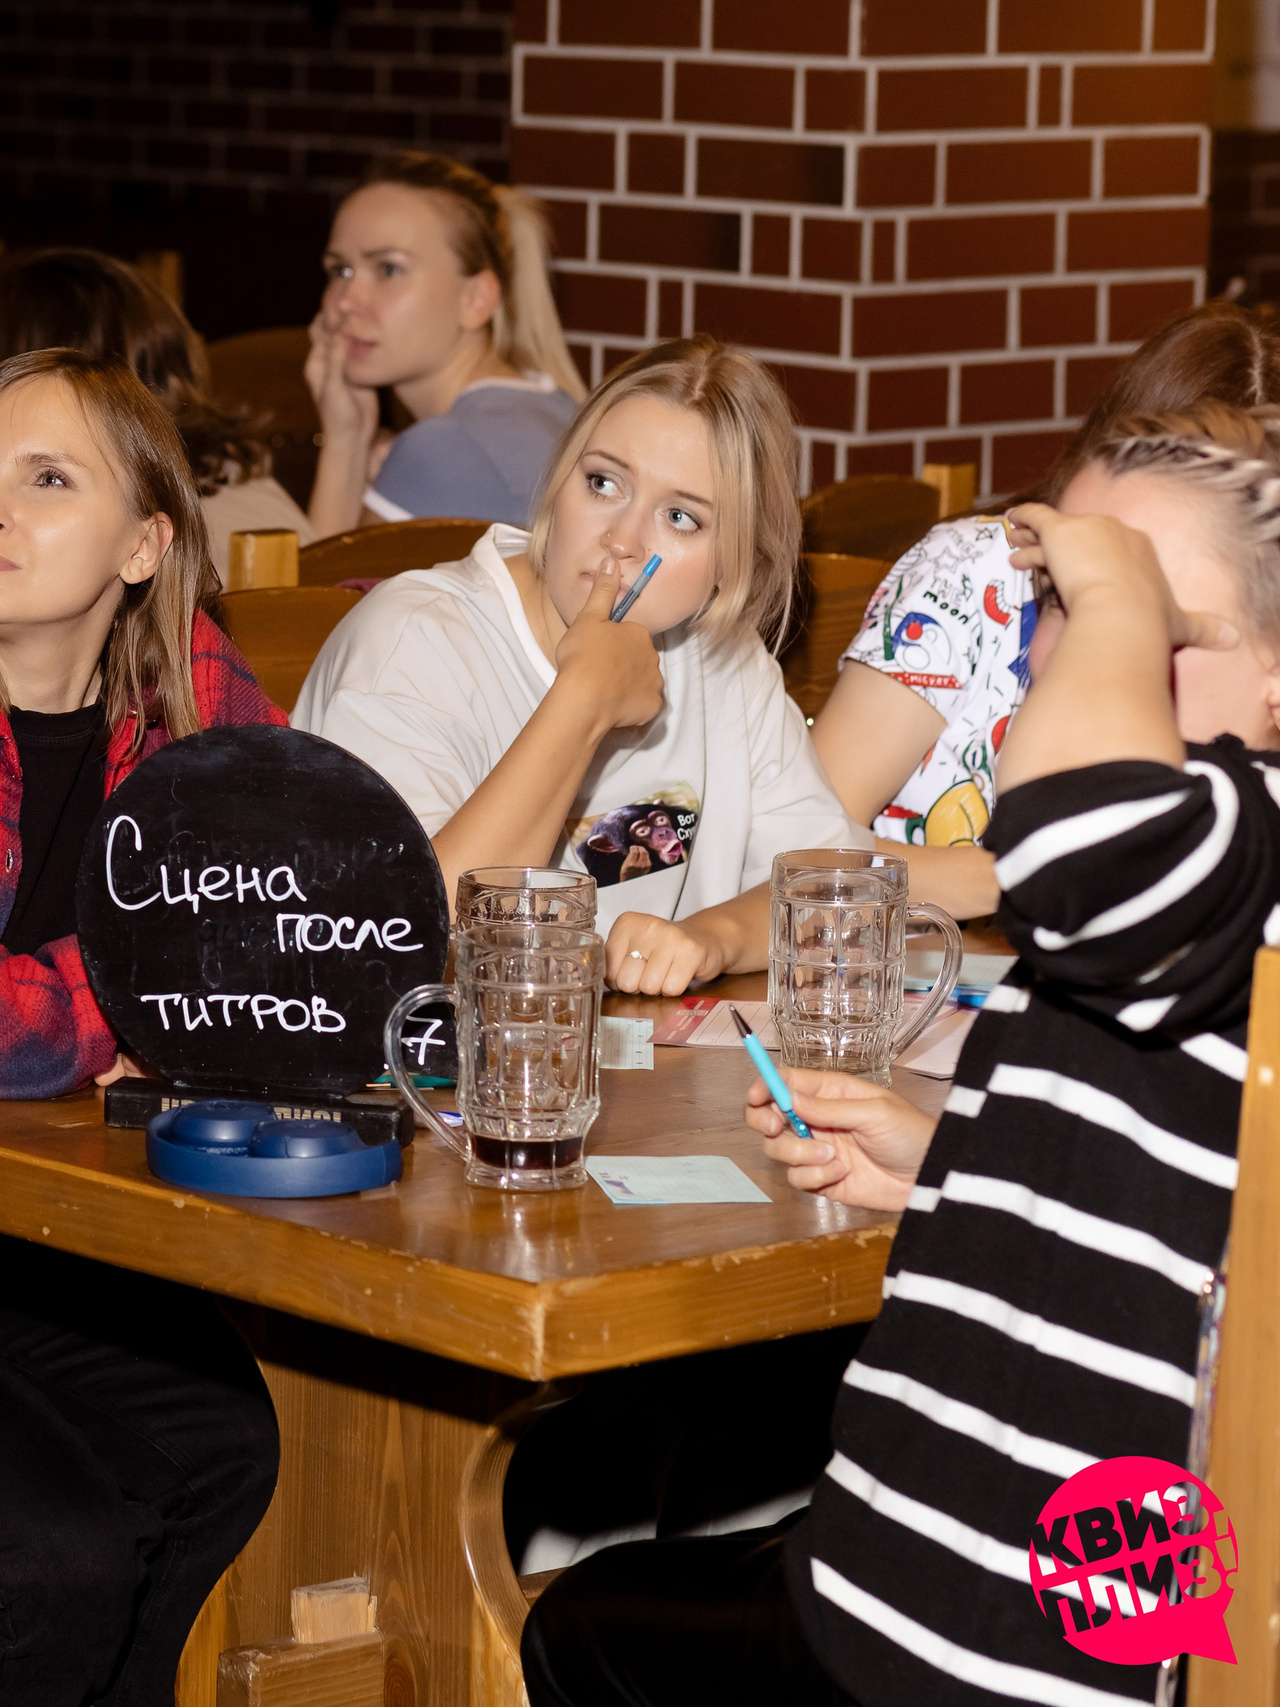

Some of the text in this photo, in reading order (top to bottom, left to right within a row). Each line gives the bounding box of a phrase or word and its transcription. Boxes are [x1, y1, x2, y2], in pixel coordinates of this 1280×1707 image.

[105, 815, 307, 914] Сцена
[276, 912, 424, 954] после
[400, 1014, 447, 1066] 7
